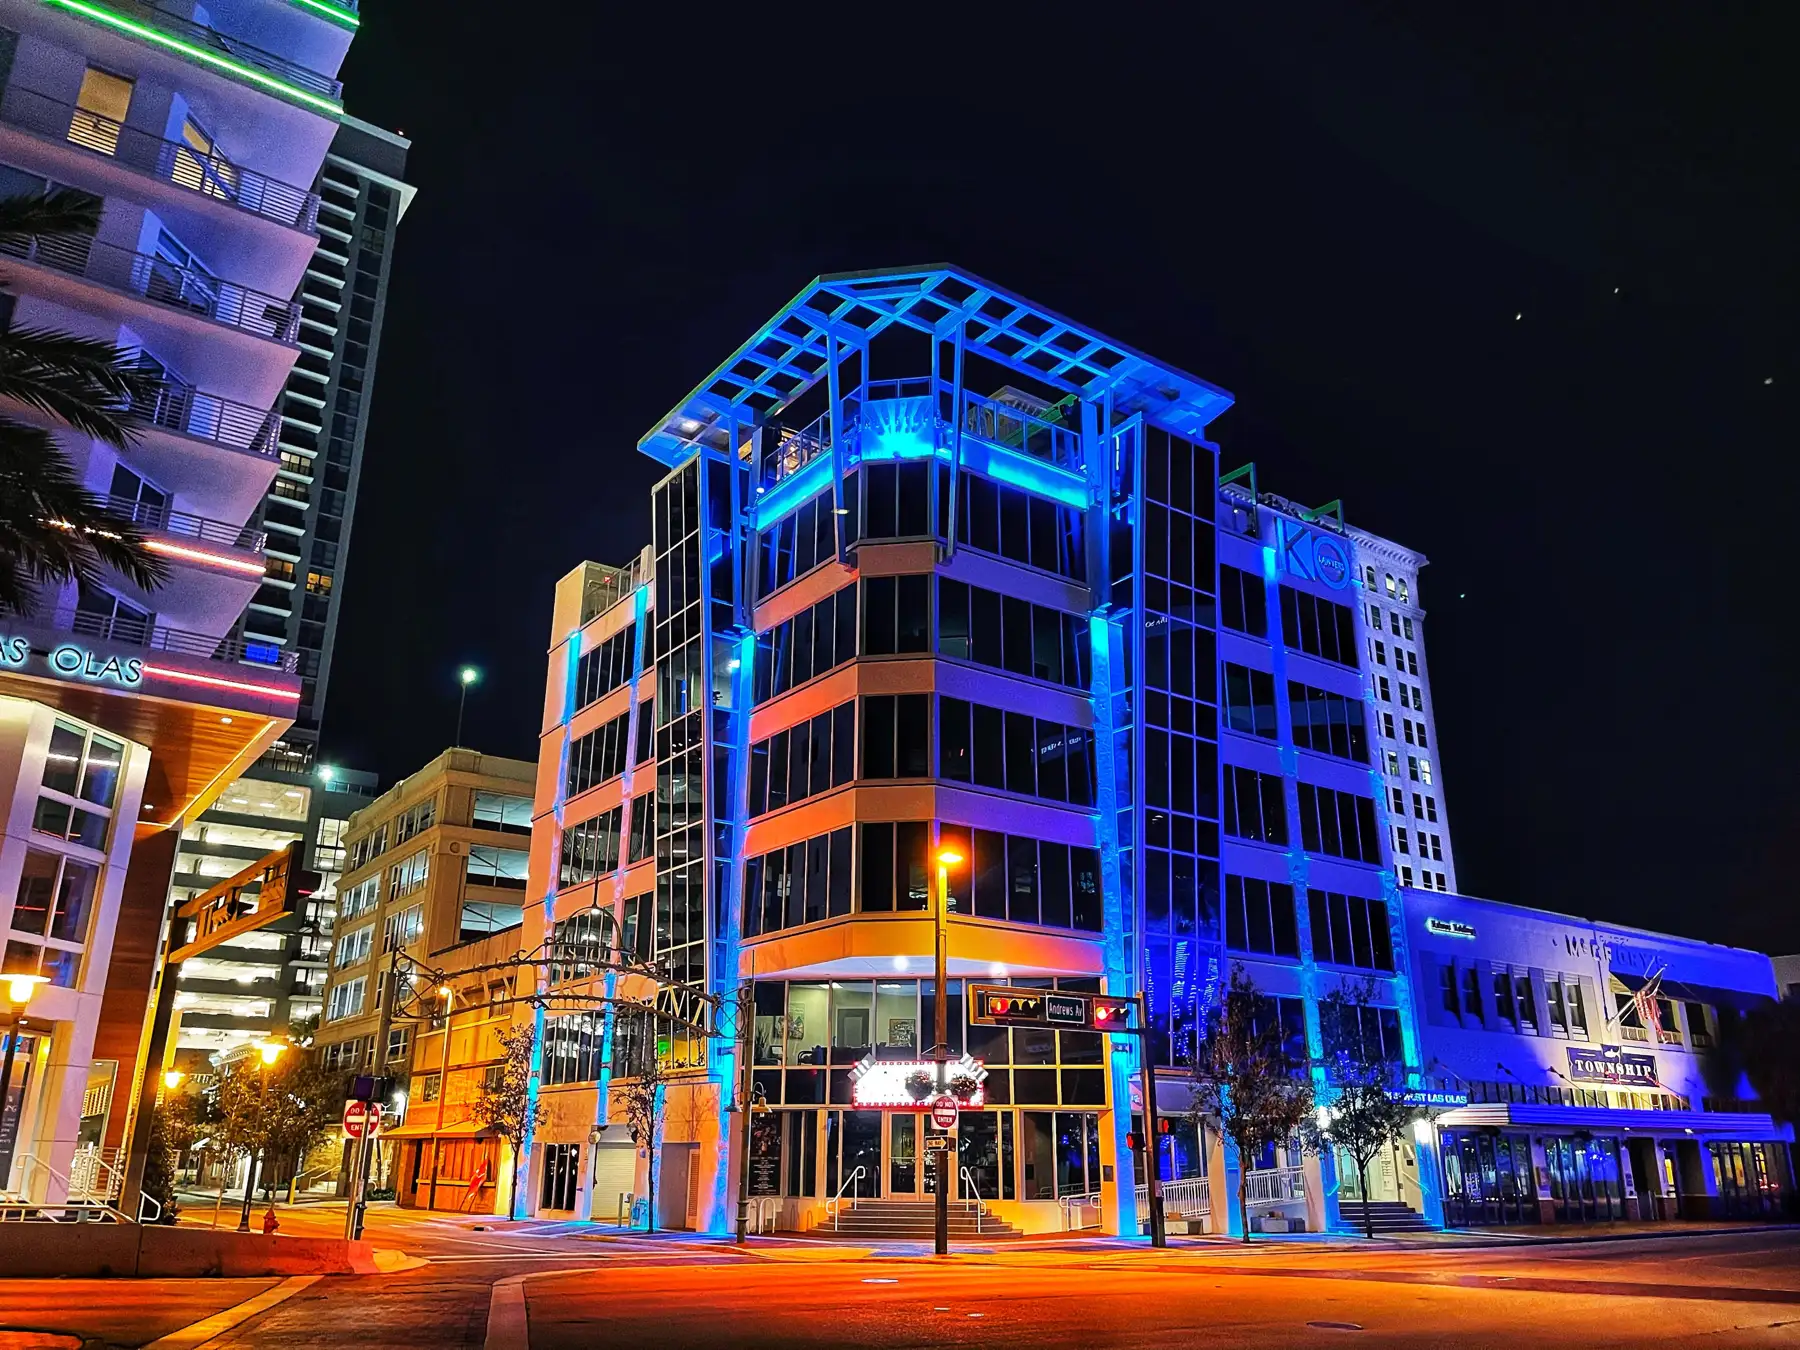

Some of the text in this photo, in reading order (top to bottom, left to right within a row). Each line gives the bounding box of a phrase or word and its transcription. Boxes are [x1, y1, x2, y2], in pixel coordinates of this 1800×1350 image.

[54, 647, 142, 683] OLAS
[1049, 1002, 1083, 1017] Andrews Av
[1574, 1059, 1652, 1077] TOWNSHIP
[1427, 1093, 1444, 1102] LAS
[1445, 1094, 1468, 1104] OLAS
